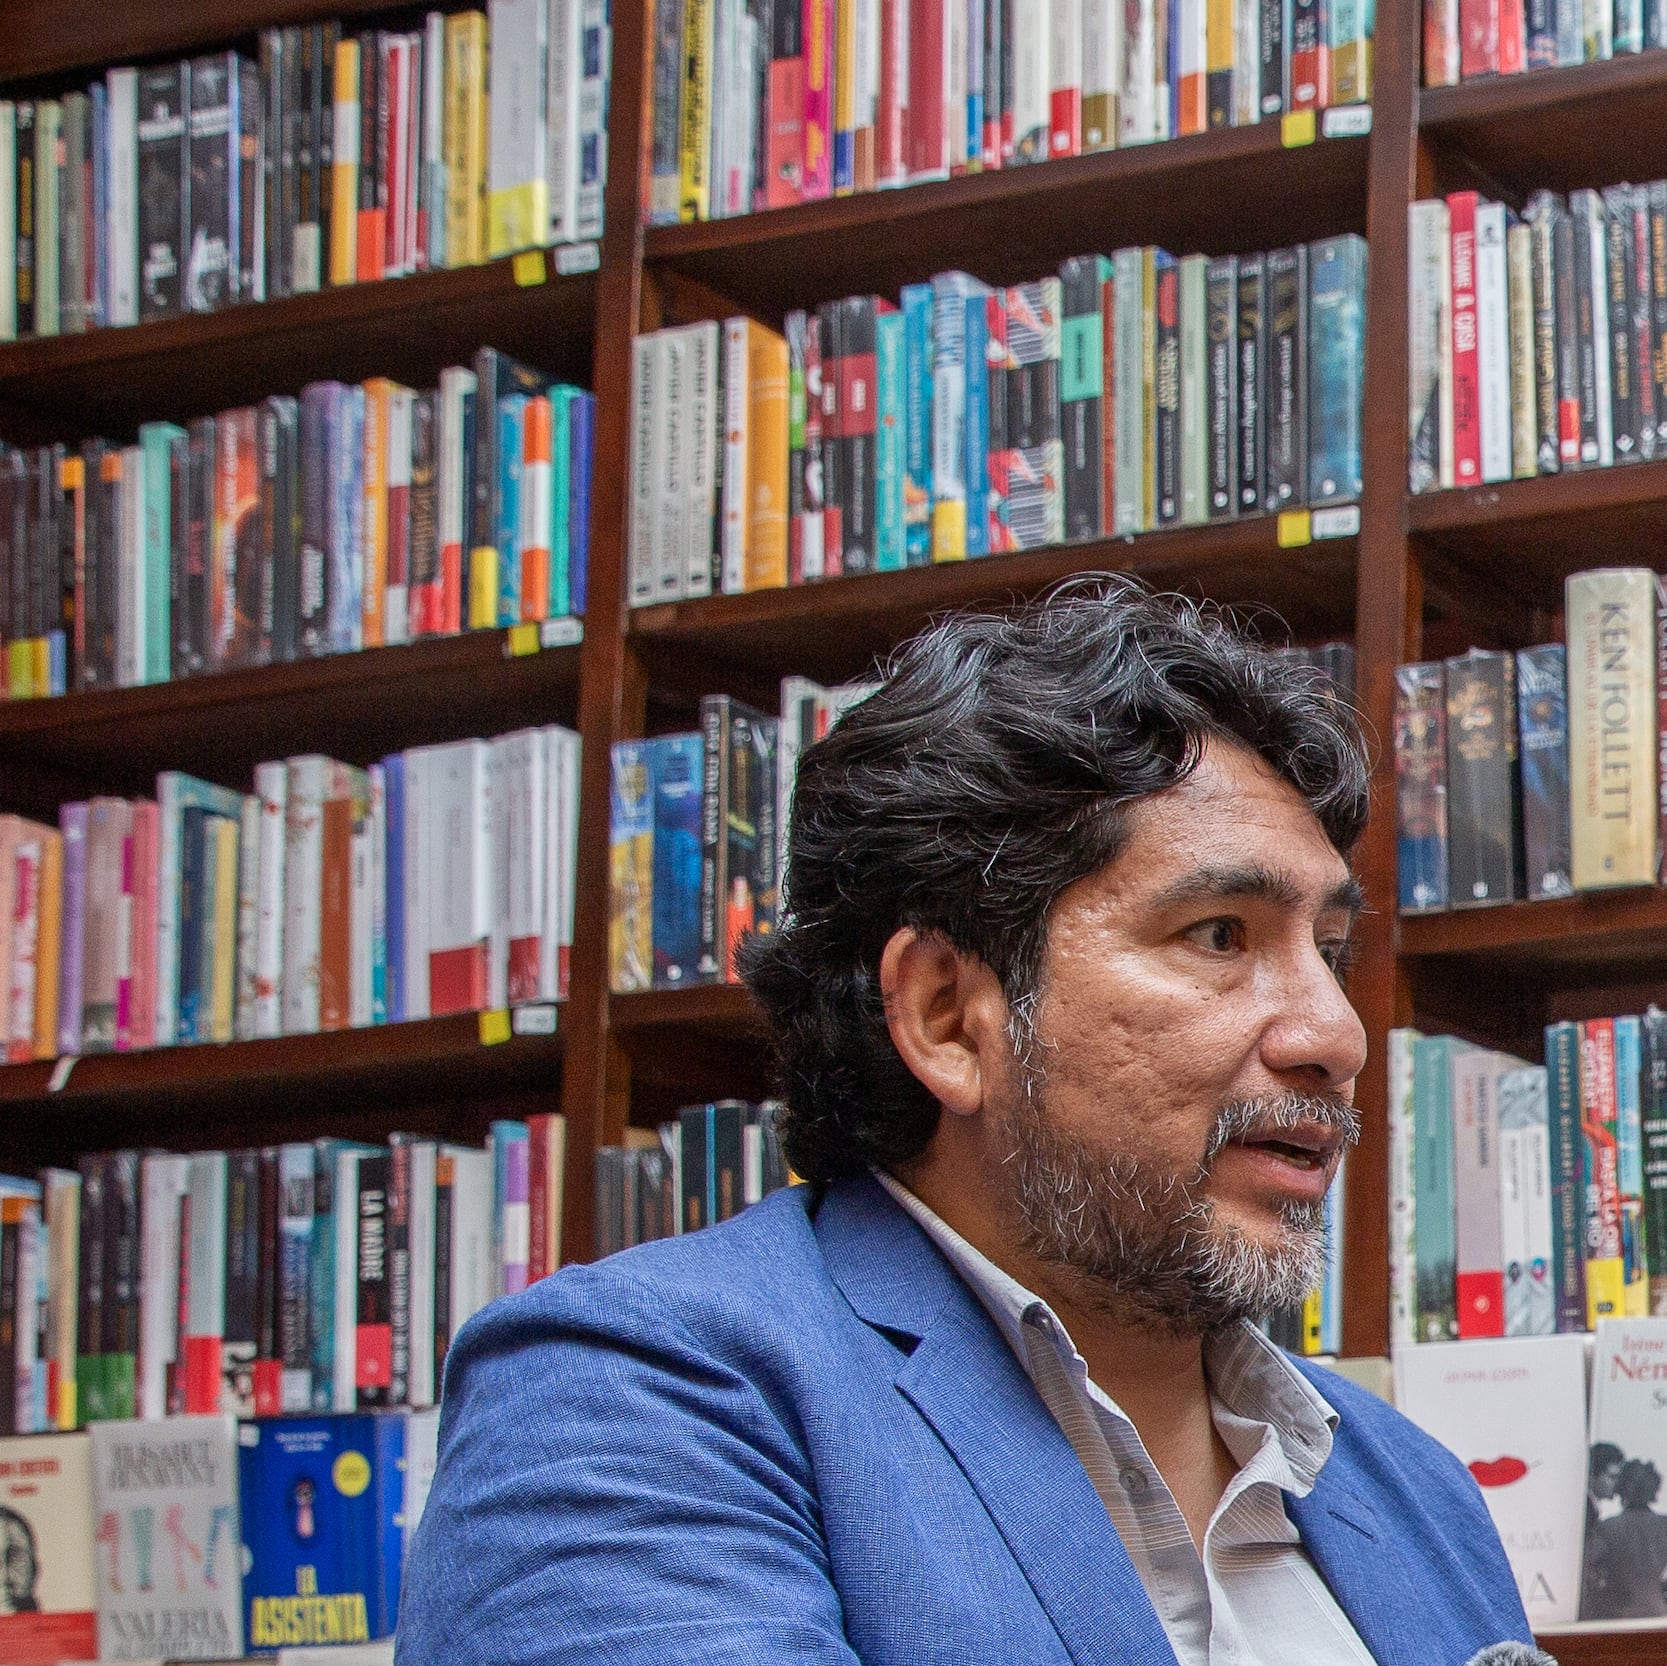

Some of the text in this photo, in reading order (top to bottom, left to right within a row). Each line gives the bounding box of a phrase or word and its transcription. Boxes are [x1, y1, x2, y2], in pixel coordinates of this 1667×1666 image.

[1601, 603, 1632, 826] KEN FOLLETT
[252, 1594, 368, 1646] ASISTENTA
